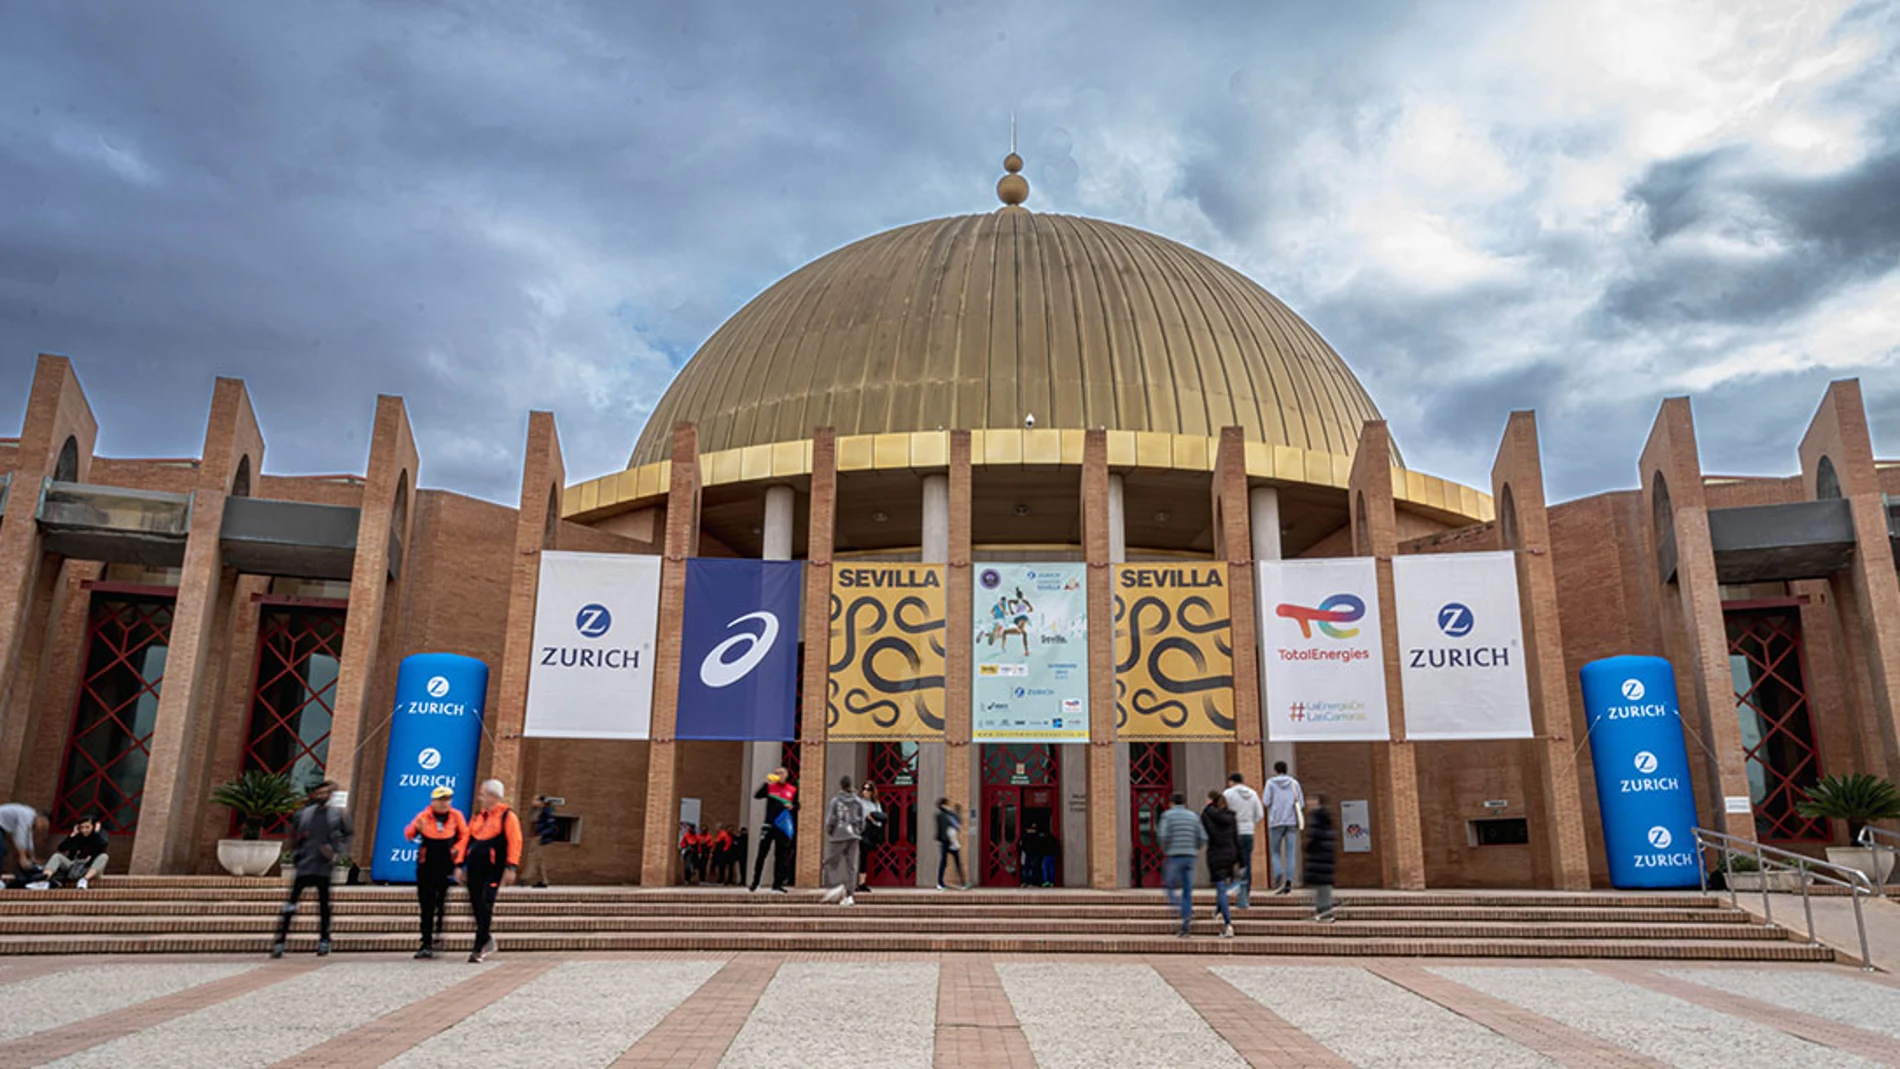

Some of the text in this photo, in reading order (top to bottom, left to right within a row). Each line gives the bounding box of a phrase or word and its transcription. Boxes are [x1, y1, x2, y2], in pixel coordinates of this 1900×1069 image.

[838, 569, 940, 588] SEVILLA
[1121, 569, 1223, 588] SEVILLA
[541, 647, 639, 669] ZURICH
[1278, 647, 1369, 663] TotalEnergies
[1409, 647, 1509, 669] ZURICH
[408, 701, 465, 716] ZURICH
[1608, 704, 1666, 720] ZURICH
[399, 774, 456, 787] ZURICH
[1621, 777, 1679, 793] ZURICH
[1634, 853, 1692, 867] ZURICH
